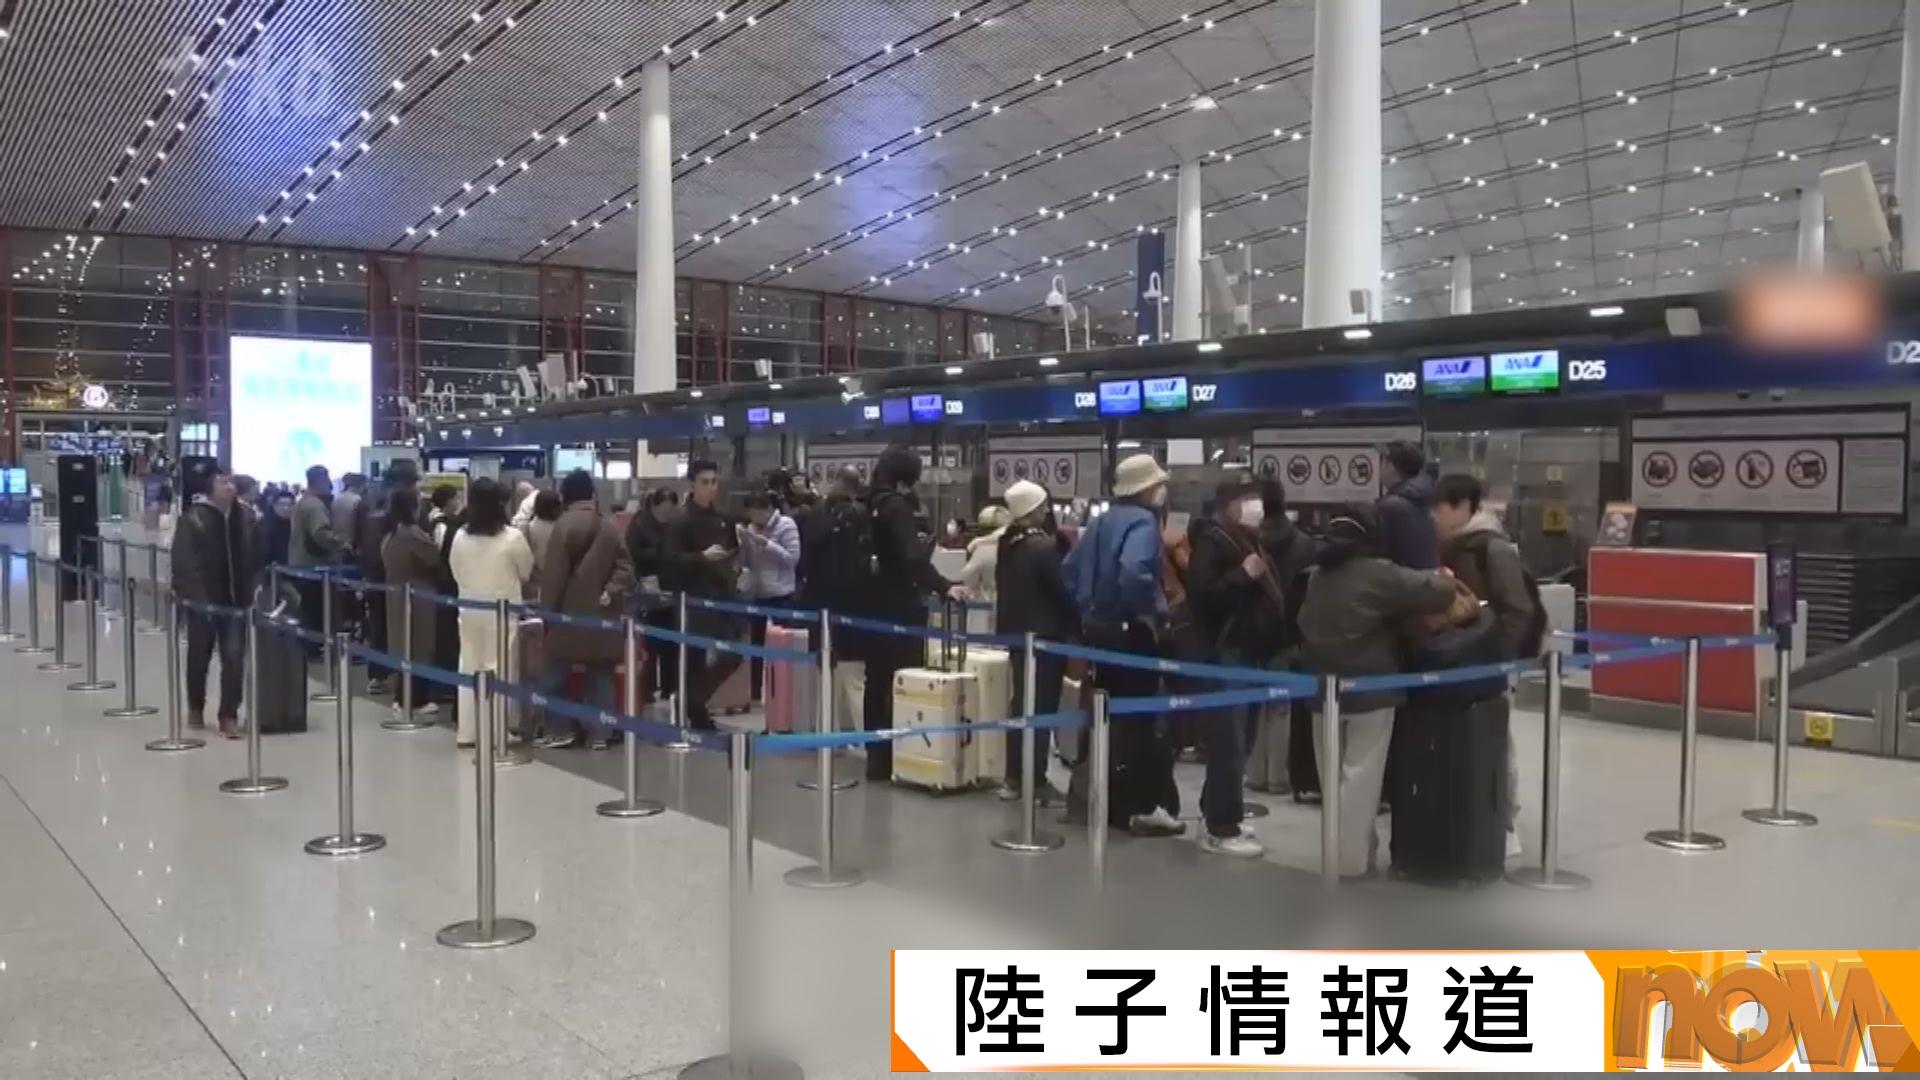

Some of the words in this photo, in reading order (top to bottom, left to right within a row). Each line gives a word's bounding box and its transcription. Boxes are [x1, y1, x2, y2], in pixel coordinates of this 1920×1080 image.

[1433, 358, 1466, 376] ANA
[1569, 359, 1606, 380] D25
[1384, 372, 1417, 391] D26
[1191, 384, 1217, 402] D27
